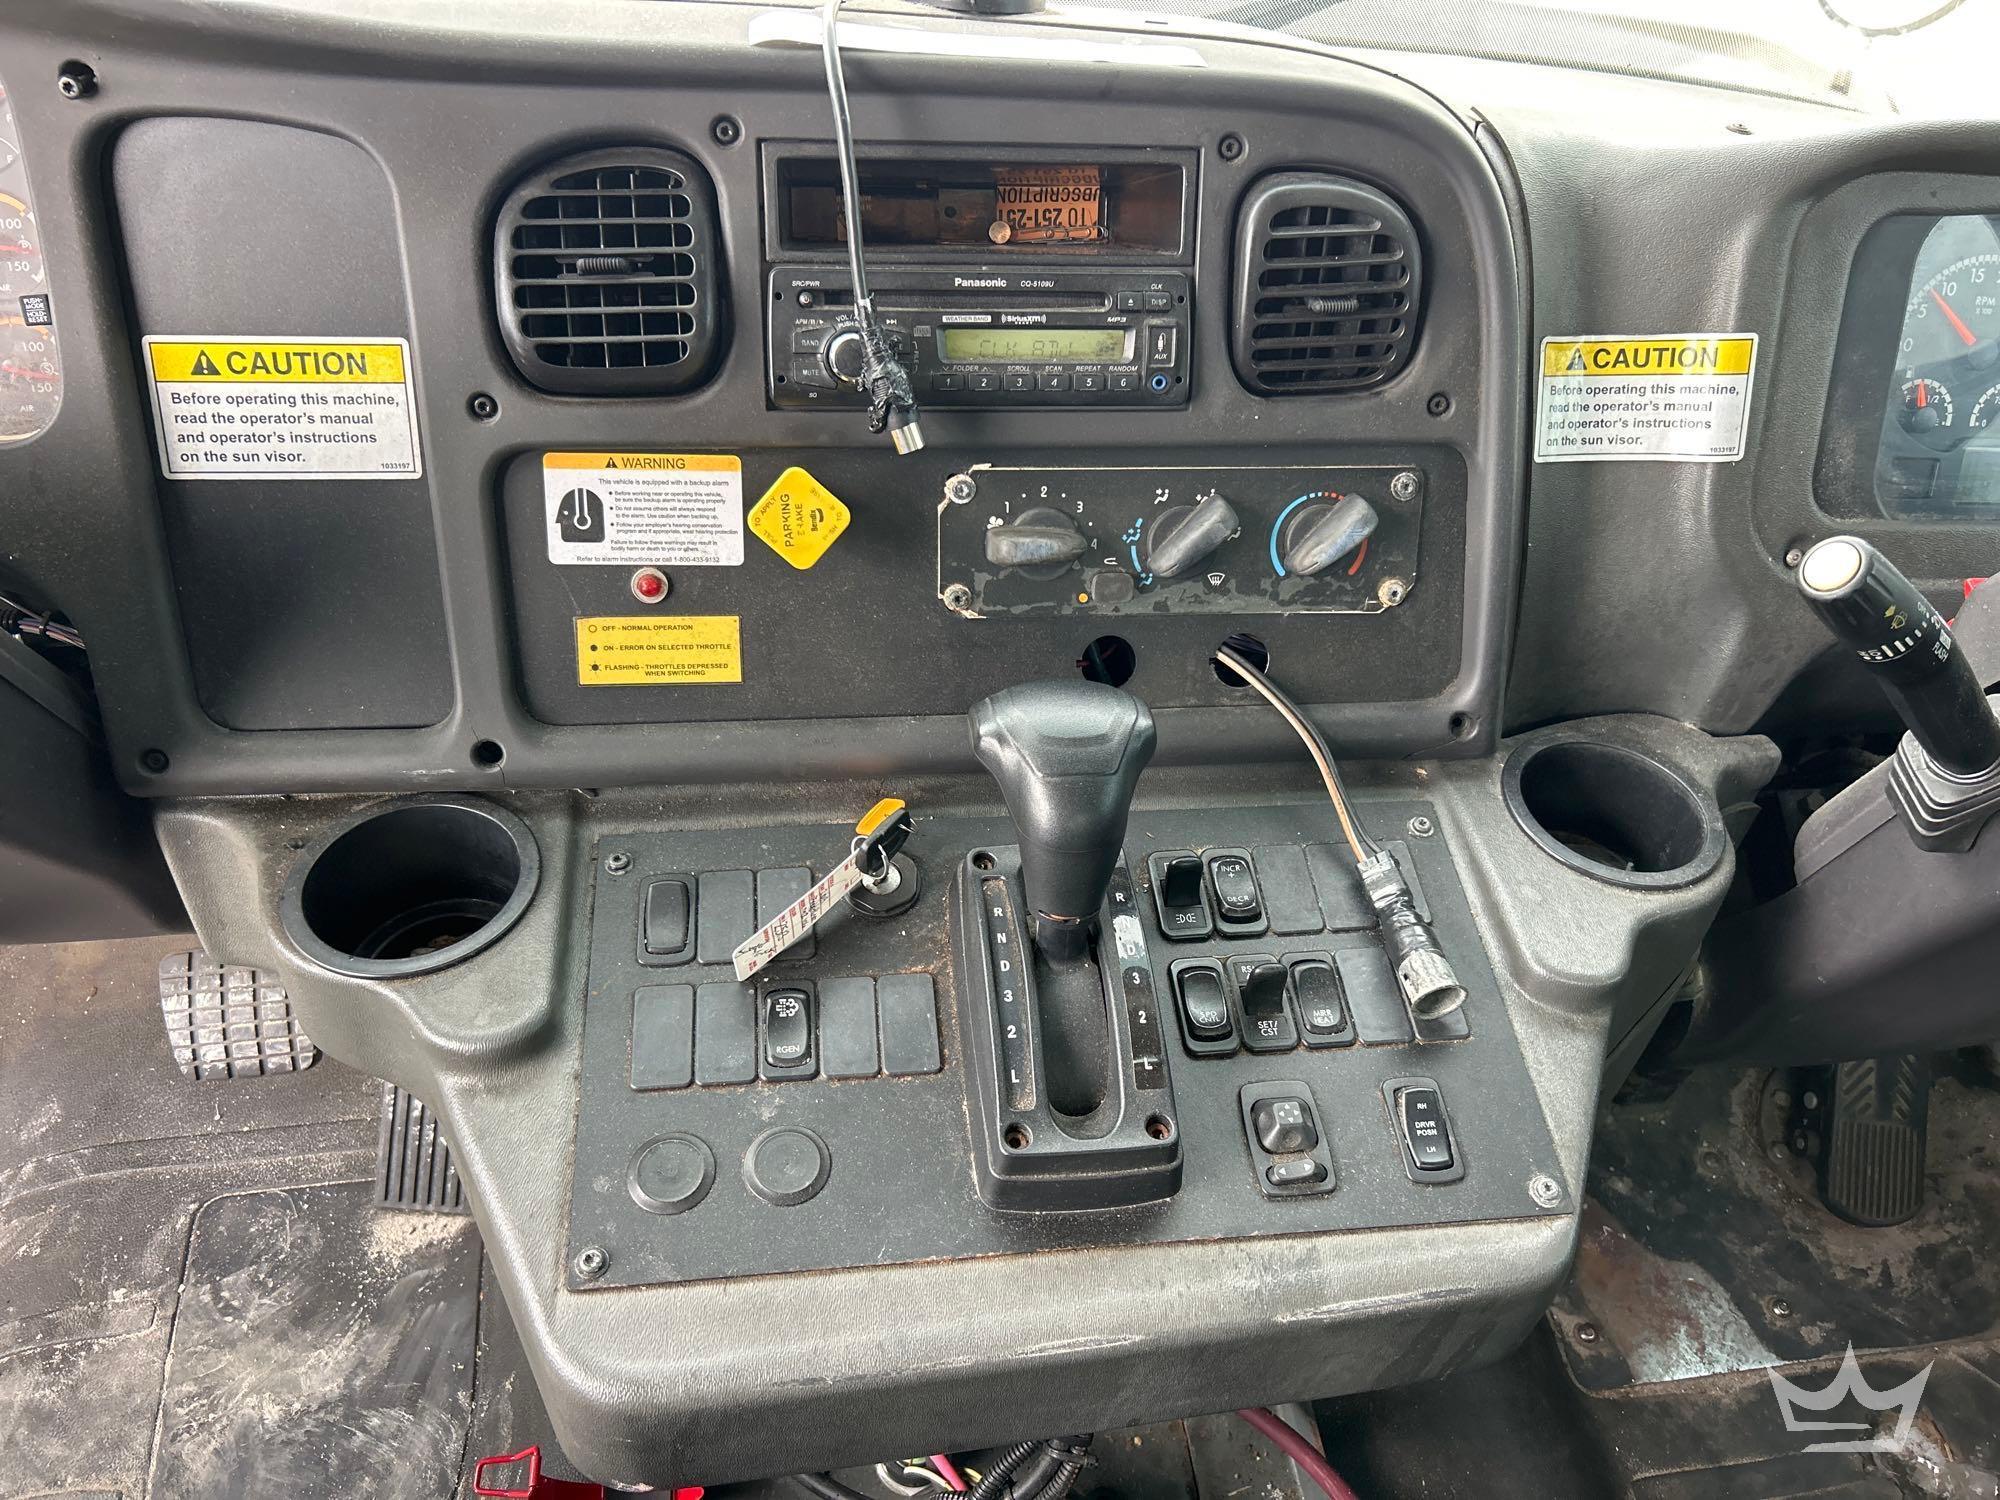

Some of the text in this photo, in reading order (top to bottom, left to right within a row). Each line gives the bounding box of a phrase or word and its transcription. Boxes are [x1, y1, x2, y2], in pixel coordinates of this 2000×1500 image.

[6, 154, 13, 164] F
[7, 261, 30, 272] 150
[1970, 268, 1985, 284] 15
[954, 277, 1007, 288] Panasonic
[1942, 281, 1957, 296] 10
[1975, 296, 1996, 306] RPM
[1917, 303, 1927, 318] 5
[21, 341, 45, 352] 100
[1903, 338, 1913, 352] 0
[226, 351, 368, 376] CAUTION
[1592, 347, 1719, 369] CAUTION
[31, 382, 53, 393] 150
[945, 378, 951, 387] 1
[981, 378, 988, 387] 2
[1016, 378, 1023, 387] 3
[1050, 378, 1058, 387] 4
[1086, 378, 1092, 387] 5
[1120, 378, 1127, 387] 6
[1550, 383, 1739, 397] Before operating this machine,
[170, 392, 400, 407] Before operating this machine,
[20, 404, 35, 412] AIR
[1549, 401, 1712, 414] read the operator's manual
[174, 413, 374, 426] read the operator's manual
[1547, 417, 1712, 430] and operator's instructions
[177, 432, 378, 445] and operator's instructions
[1546, 434, 1643, 446] on the sun visor.
[180, 451, 306, 463] on the sun visor.
[621, 457, 686, 470] WARNING
[642, 479, 670, 487] equipped
[689, 479, 711, 487] backup
[1040, 486, 1049, 498] 2
[1004, 501, 1010, 513] 1
[1076, 501, 1084, 513] 3
[780, 493, 794, 547] PARKING
[810, 510, 819, 532] Bendix
[1090, 538, 1098, 551] 4
[1220, 864, 1241, 873] INCR
[1115, 892, 1125, 902] R
[1226, 895, 1250, 903] DECR
[993, 907, 1003, 917] R
[996, 933, 1007, 943] N
[1126, 944, 1136, 955] D
[1000, 960, 1010, 971] D
[1132, 972, 1141, 985] 3
[1003, 990, 1013, 1002] 3
[1138, 1010, 1147, 1024] 2
[1313, 1009, 1332, 1017] MRR
[1257, 1021, 1278, 1029] SET/
[1313, 1016, 1334, 1024] HEAT
[1007, 1025, 1017, 1039] 2
[1260, 1027, 1278, 1036] CST
[776, 1045, 800, 1053] RGEN
[1143, 1057, 1153, 1070] L
[1010, 1069, 1020, 1083] L
[1417, 1102, 1427, 1110] RH
[1415, 1120, 1436, 1128] DRVR
